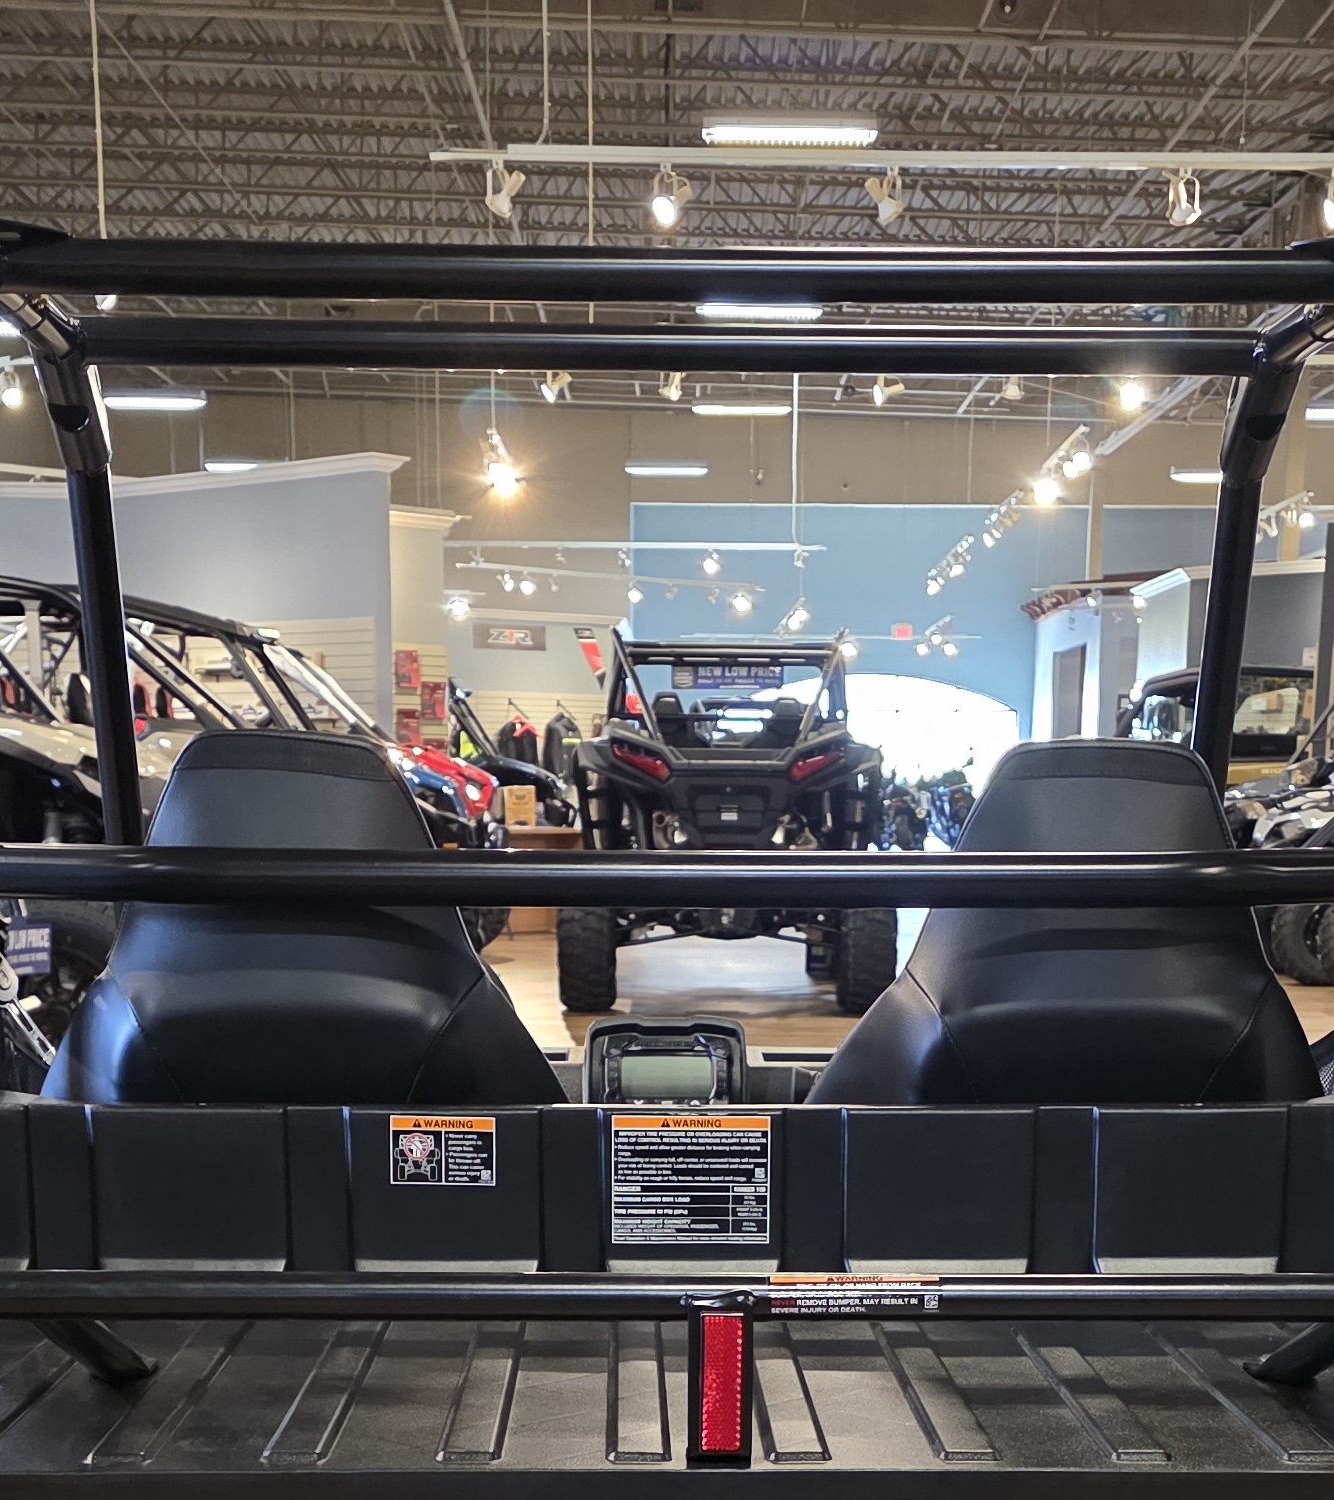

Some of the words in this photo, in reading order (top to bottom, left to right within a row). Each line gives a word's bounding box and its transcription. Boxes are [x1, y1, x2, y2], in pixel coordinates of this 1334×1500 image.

[698, 666, 722, 677] NEW
[725, 666, 749, 677] LOW
[750, 666, 782, 677] PRICE
[423, 1120, 474, 1129] WARNING
[672, 1119, 722, 1128] WARNING
